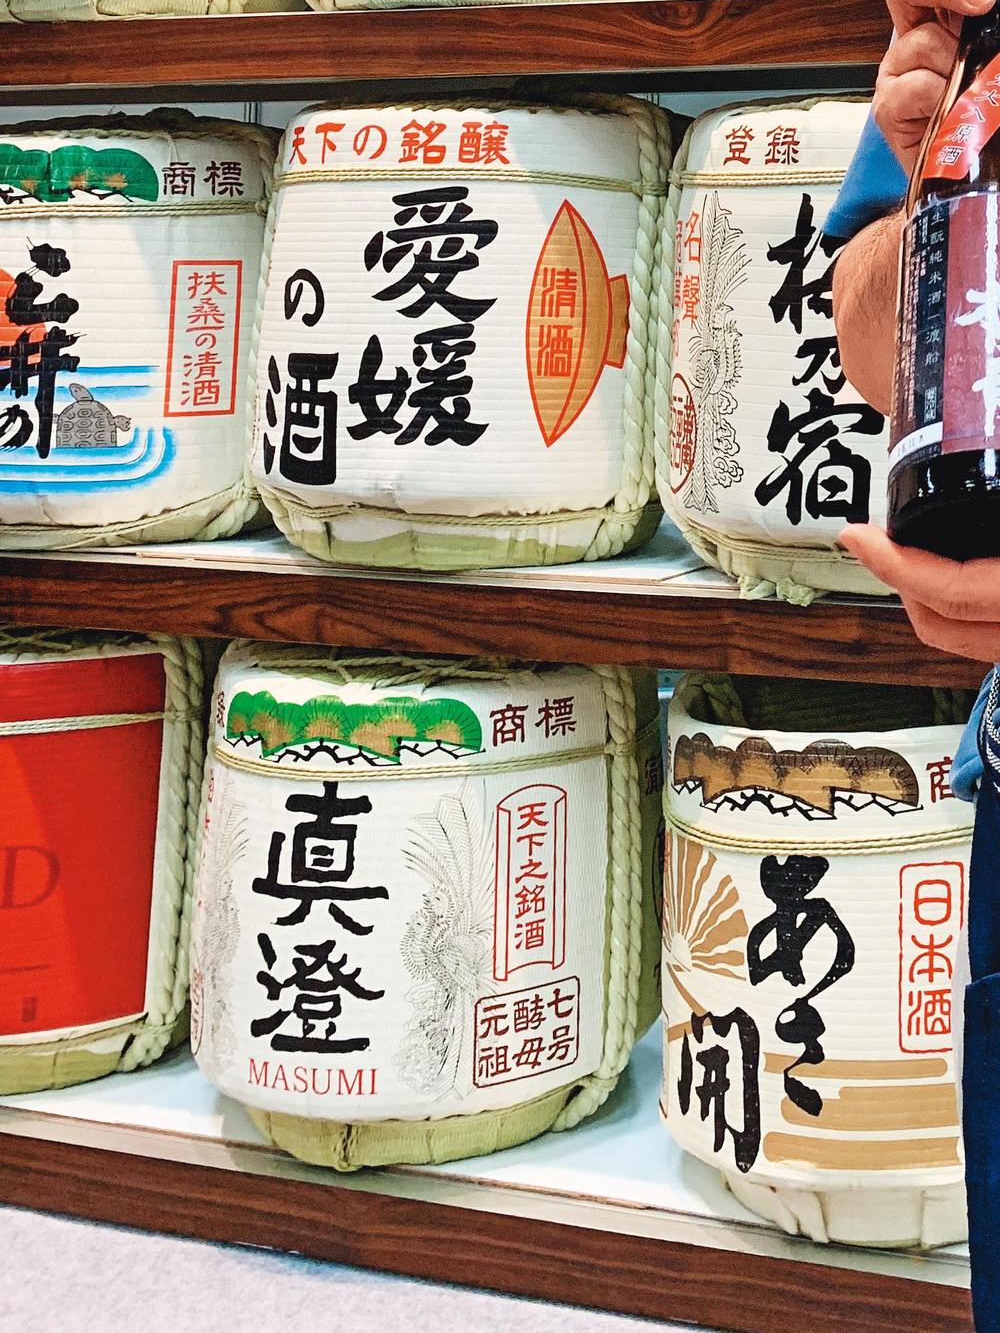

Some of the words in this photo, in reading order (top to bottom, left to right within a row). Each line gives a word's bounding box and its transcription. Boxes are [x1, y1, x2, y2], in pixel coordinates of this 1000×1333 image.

[162, 160, 245, 198] 商標
[288, 119, 512, 166] 天下の銘醸
[722, 124, 801, 166] 登録
[180, 271, 228, 407] 扶桑の清酒
[346, 186, 500, 446] 愛媛
[536, 268, 579, 379] 清酒
[263, 268, 340, 486] の酒
[489, 696, 579, 747] 商標
[514, 801, 550, 953] 天下之銘酒
[907, 878, 955, 1038] 日本酒
[246, 1056, 380, 1098] MASUMI
